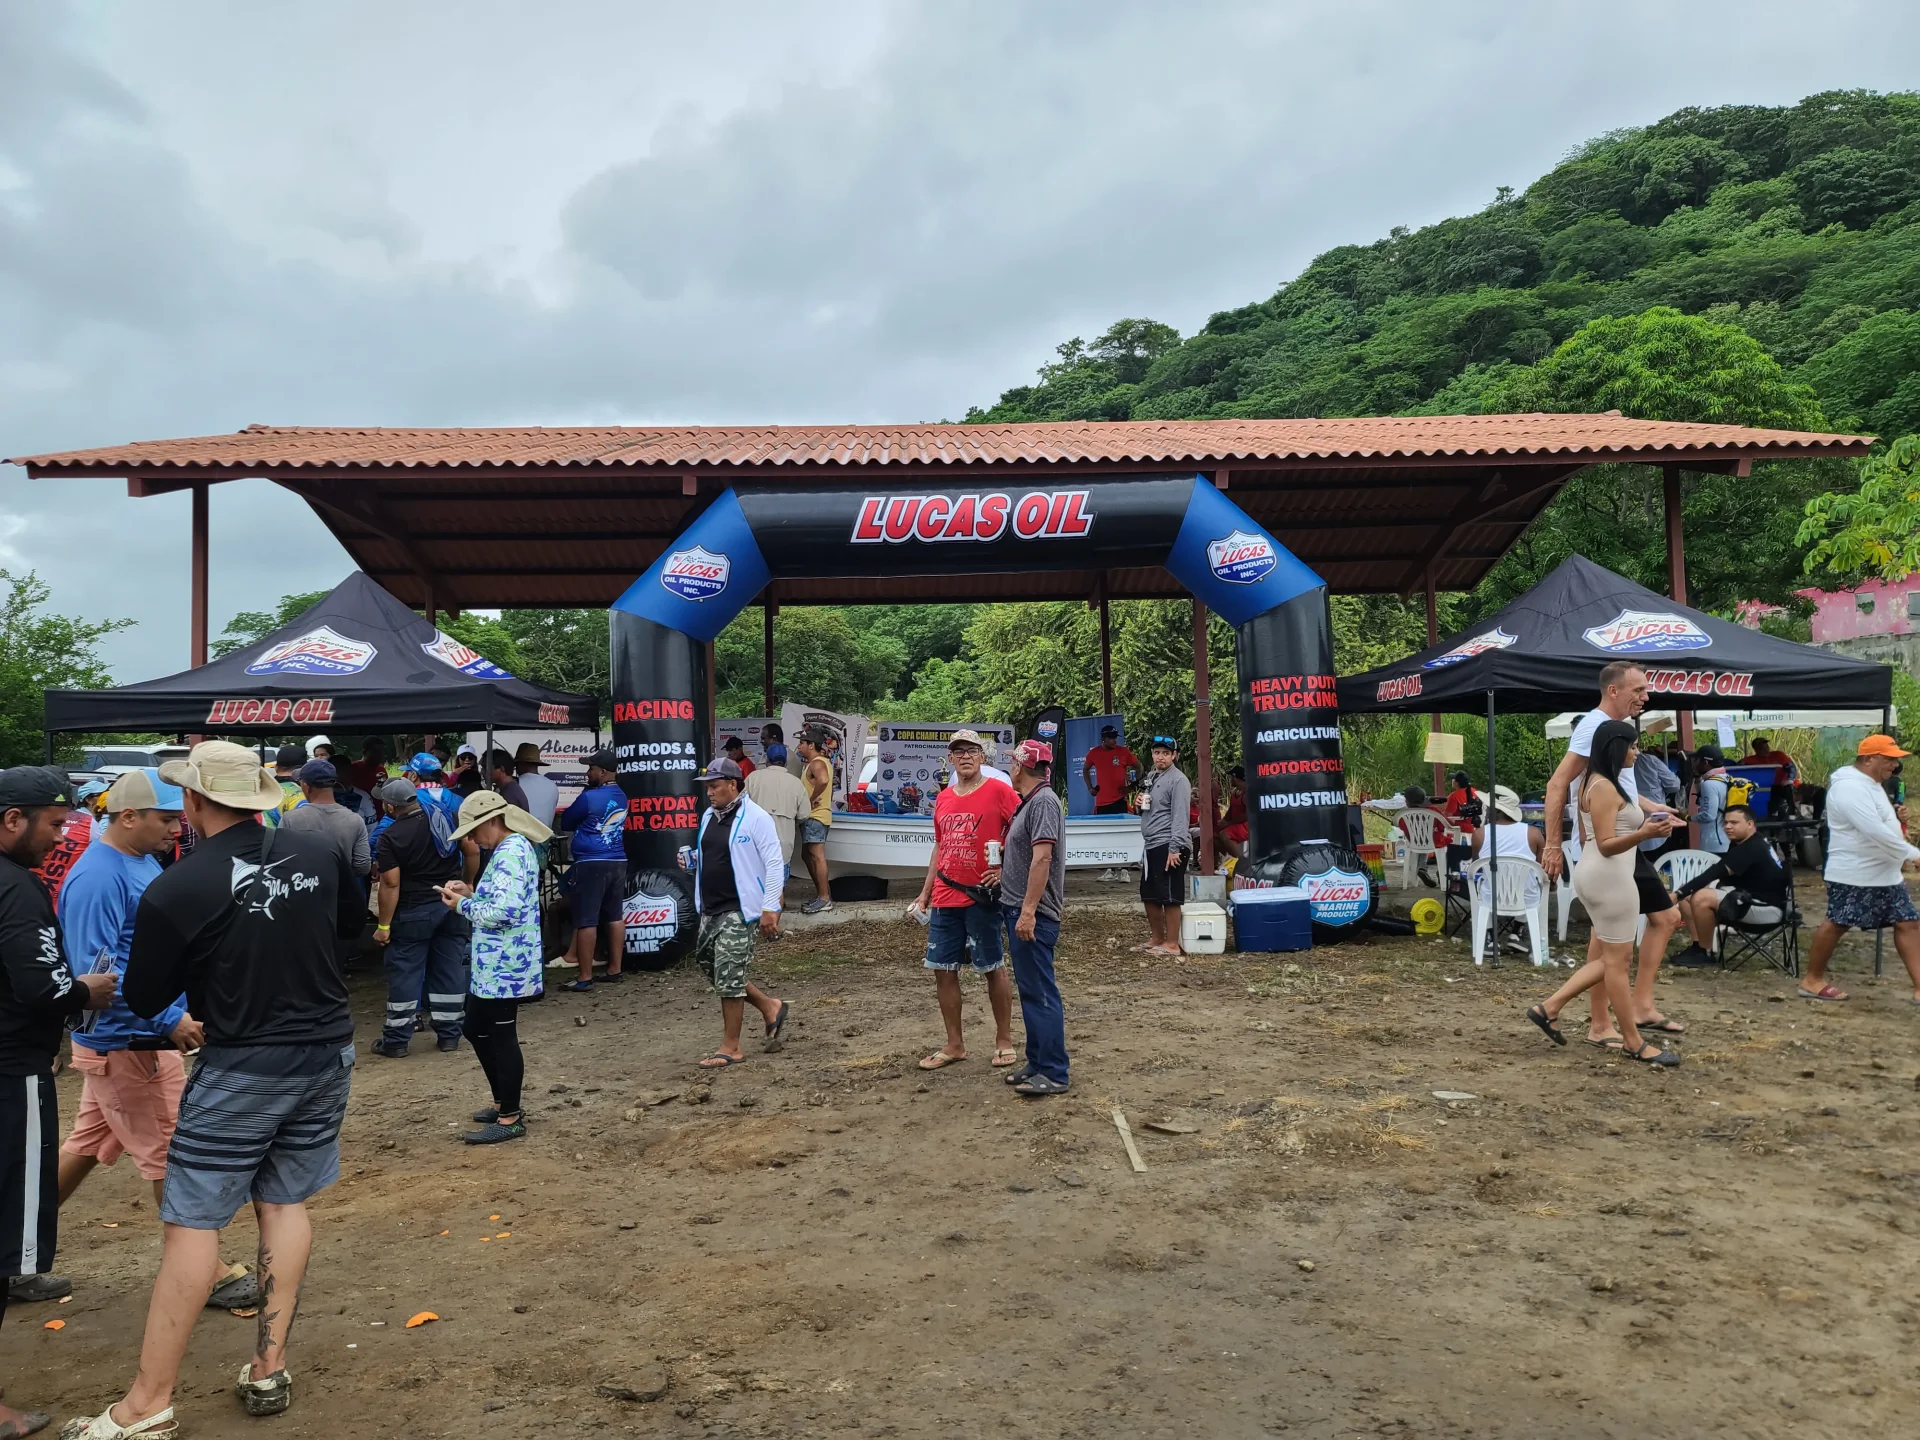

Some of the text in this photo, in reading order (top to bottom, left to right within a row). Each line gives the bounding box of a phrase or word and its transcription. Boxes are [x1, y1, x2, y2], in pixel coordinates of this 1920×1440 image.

[850, 491, 1094, 543] LUCAS OIL
[1219, 545, 1266, 565] LUCAS
[669, 562, 723, 578] LUCAS
[1232, 558, 1274, 572] PRODUCTS
[1240, 570, 1257, 578] INC.
[679, 577, 721, 590] PRODUCTS
[683, 586, 700, 595] INC.
[1611, 623, 1687, 644] LUCAS
[1611, 642, 1636, 651] OIL
[1251, 675, 1337, 695] HEAVY DUTY
[1377, 674, 1422, 702] LUCAS OIL
[1646, 670, 1754, 697] LUCAS OIL
[1252, 691, 1339, 713] TRUCKING
[206, 698, 336, 725] LUCAS OIL
[614, 699, 694, 723] RACING
[897, 731, 914, 740] COPA
[915, 732, 939, 740] CHAME
[1256, 727, 1340, 744] AGRICULTURE
[616, 742, 696, 759] HOT RODS &
[616, 759, 697, 774] CLASSIC CARS
[1260, 791, 1346, 810] INDUSTRIAL
[624, 813, 698, 831] AR CARE
[262, 872, 319, 899] My Boys
[1311, 887, 1363, 901] LUCAS
[1316, 910, 1358, 918] PRODUCTS
[1318, 902, 1360, 911] MARINE
[623, 908, 670, 924] UCAS
[626, 940, 659, 953] LINE
